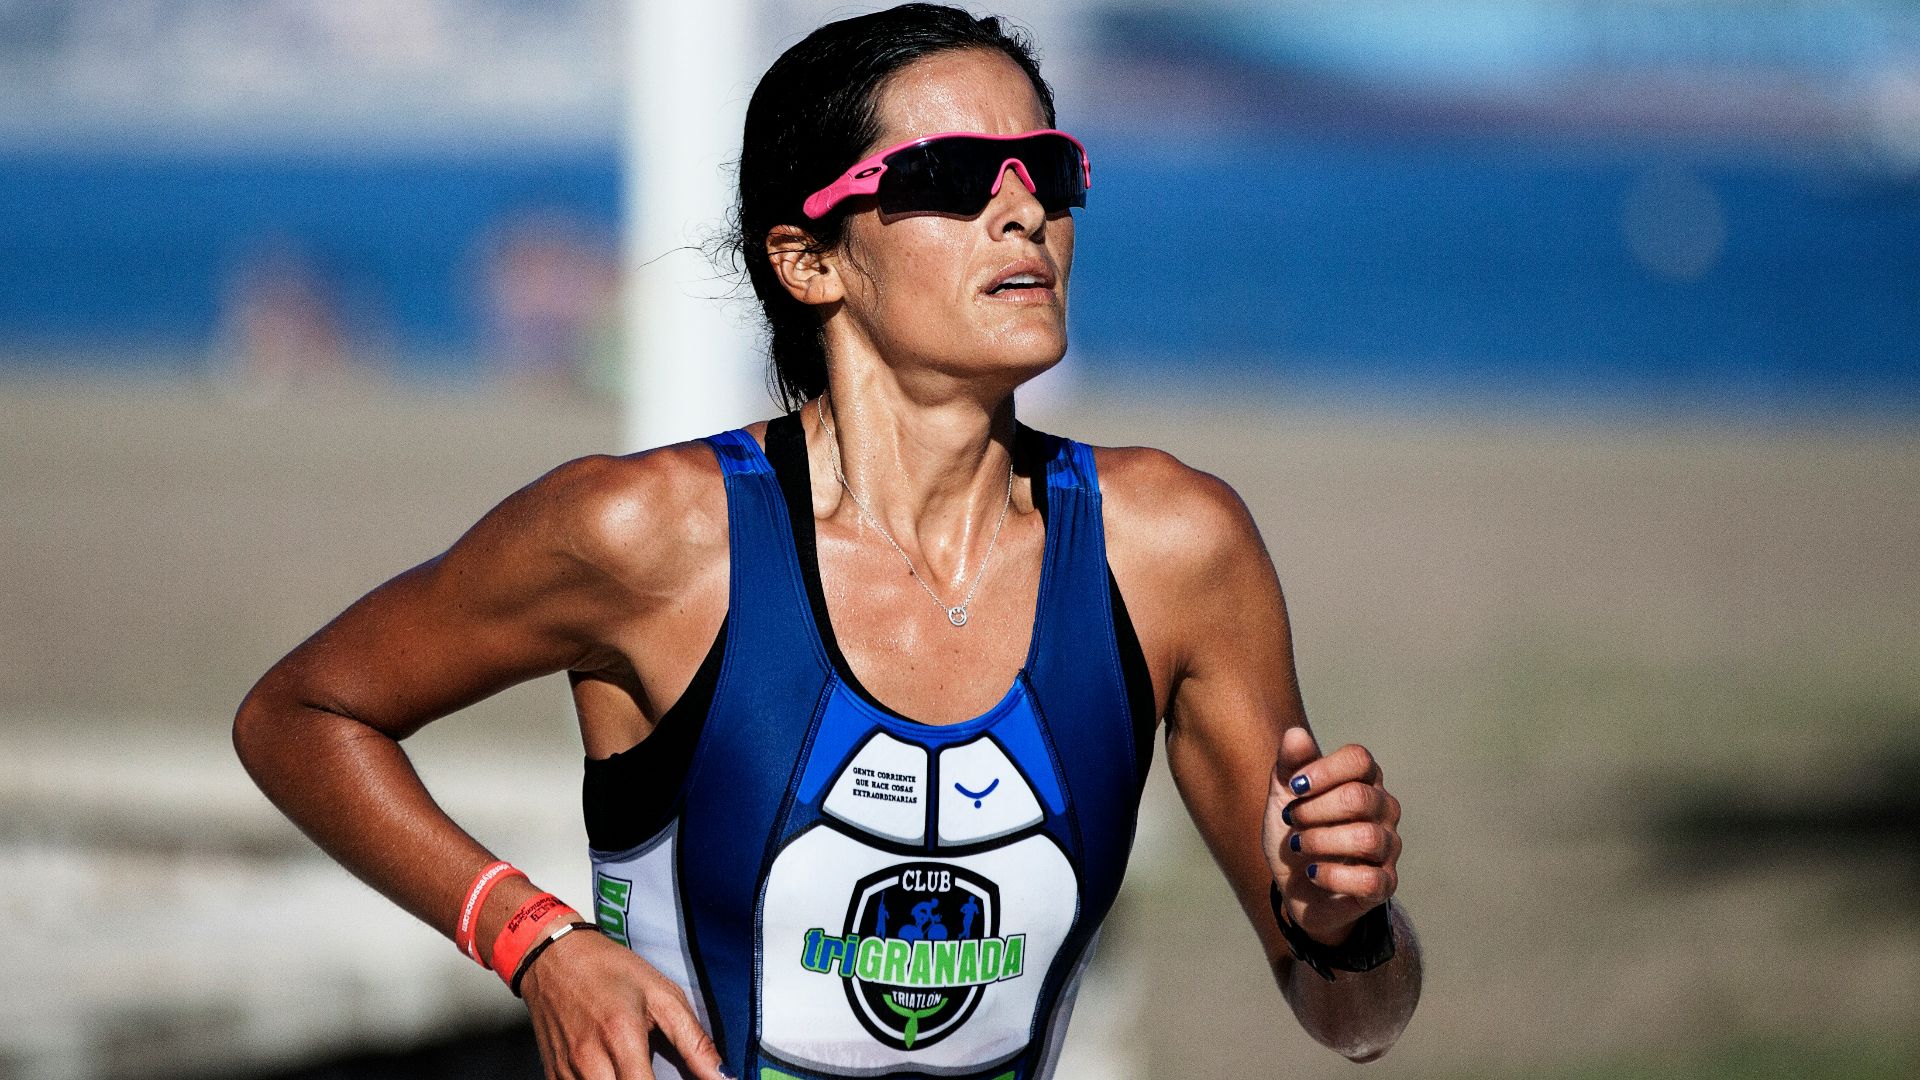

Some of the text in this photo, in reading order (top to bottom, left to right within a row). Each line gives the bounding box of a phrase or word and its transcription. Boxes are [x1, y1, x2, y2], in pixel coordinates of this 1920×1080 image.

[852, 767, 916, 783] GENTE CORRIENTE
[855, 778, 914, 793] QUE HACE COSAS
[852, 788, 917, 804] EXTRAORDINARIAS
[902, 869, 951, 893] CLUB
